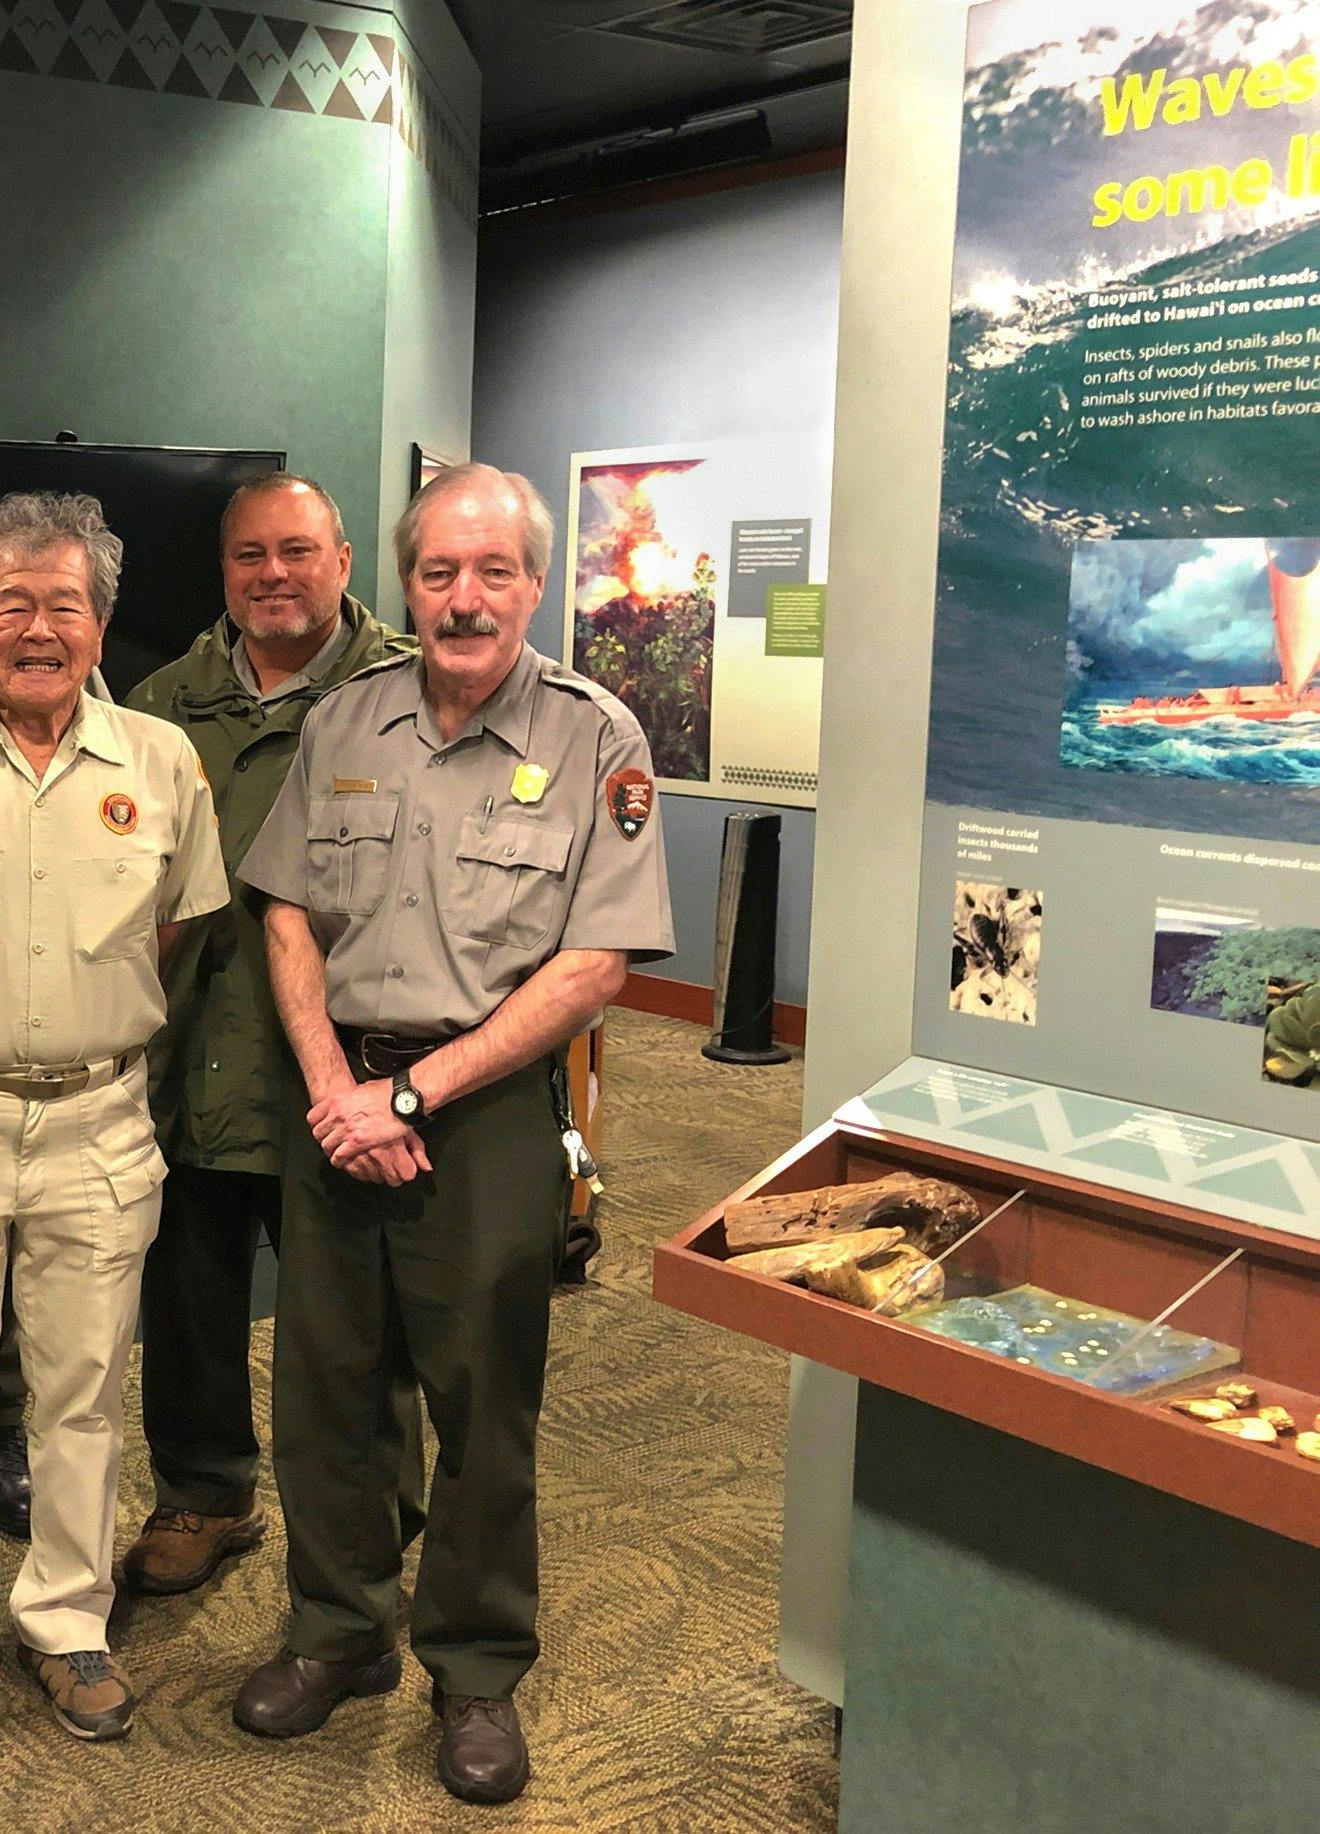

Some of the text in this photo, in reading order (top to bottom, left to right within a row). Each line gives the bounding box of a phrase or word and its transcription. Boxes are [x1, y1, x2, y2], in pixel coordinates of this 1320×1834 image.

[1101, 53, 1318, 136] Waves
[1091, 158, 1273, 228] some
[1088, 267, 1319, 308] Buoyant, salt-tolerant seeds
[1087, 310, 1141, 330] drifted
[1144, 310, 1161, 323] to
[1228, 301, 1250, 314] on
[1253, 295, 1305, 311] ocean
[1084, 348, 1135, 364] Insects,
[1139, 342, 1190, 361] spiders
[1194, 337, 1222, 352] and
[1226, 333, 1267, 350] snails
[1271, 331, 1302, 347] also
[1083, 373, 1101, 385] on
[1105, 368, 1135, 384] rafts
[1138, 366, 1155, 380] of
[1156, 361, 1207, 380] woody
[1209, 359, 1260, 375] debris.
[1265, 354, 1310, 369] These
[1081, 390, 1135, 407] animals
[1139, 384, 1199, 402] survived
[1203, 383, 1213, 398] if
[1216, 381, 1250, 399] they
[1253, 379, 1291, 394] were
[1081, 416, 1095, 428] to
[1098, 412, 1134, 427] wash
[1137, 409, 1185, 424] ashore
[1189, 407, 1203, 420] in
[1206, 403, 1268, 419] habitats
[990, 839, 1039, 853] thousands
[1005, 829, 1039, 840] carried
[957, 849, 992, 861] of miles
